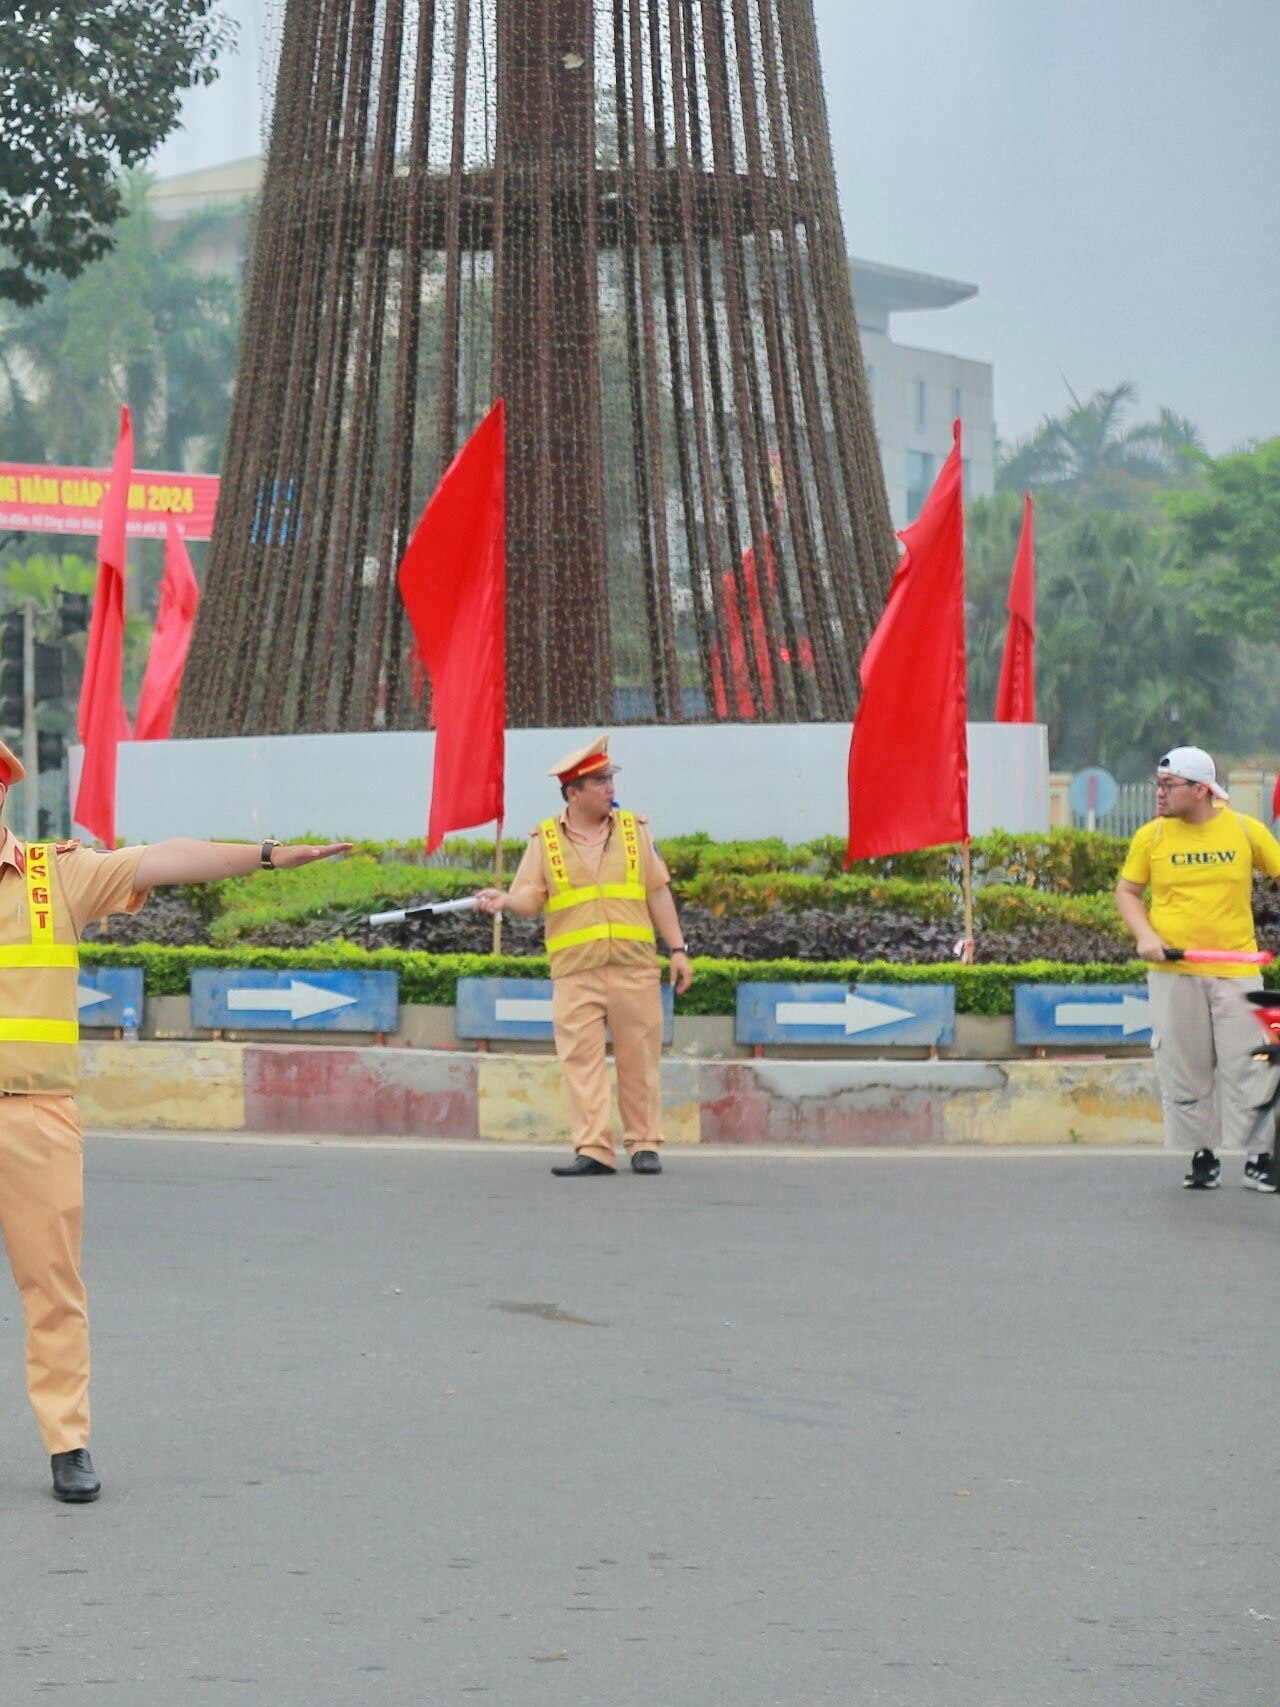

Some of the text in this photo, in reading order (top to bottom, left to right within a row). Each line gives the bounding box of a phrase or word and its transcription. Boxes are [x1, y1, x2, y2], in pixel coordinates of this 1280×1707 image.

[147, 484, 194, 514] 2024
[546, 828, 564, 880] CSGT
[622, 818, 637, 870] CSGT
[1171, 851, 1236, 866] CREW
[29, 846, 49, 929] CSGT
